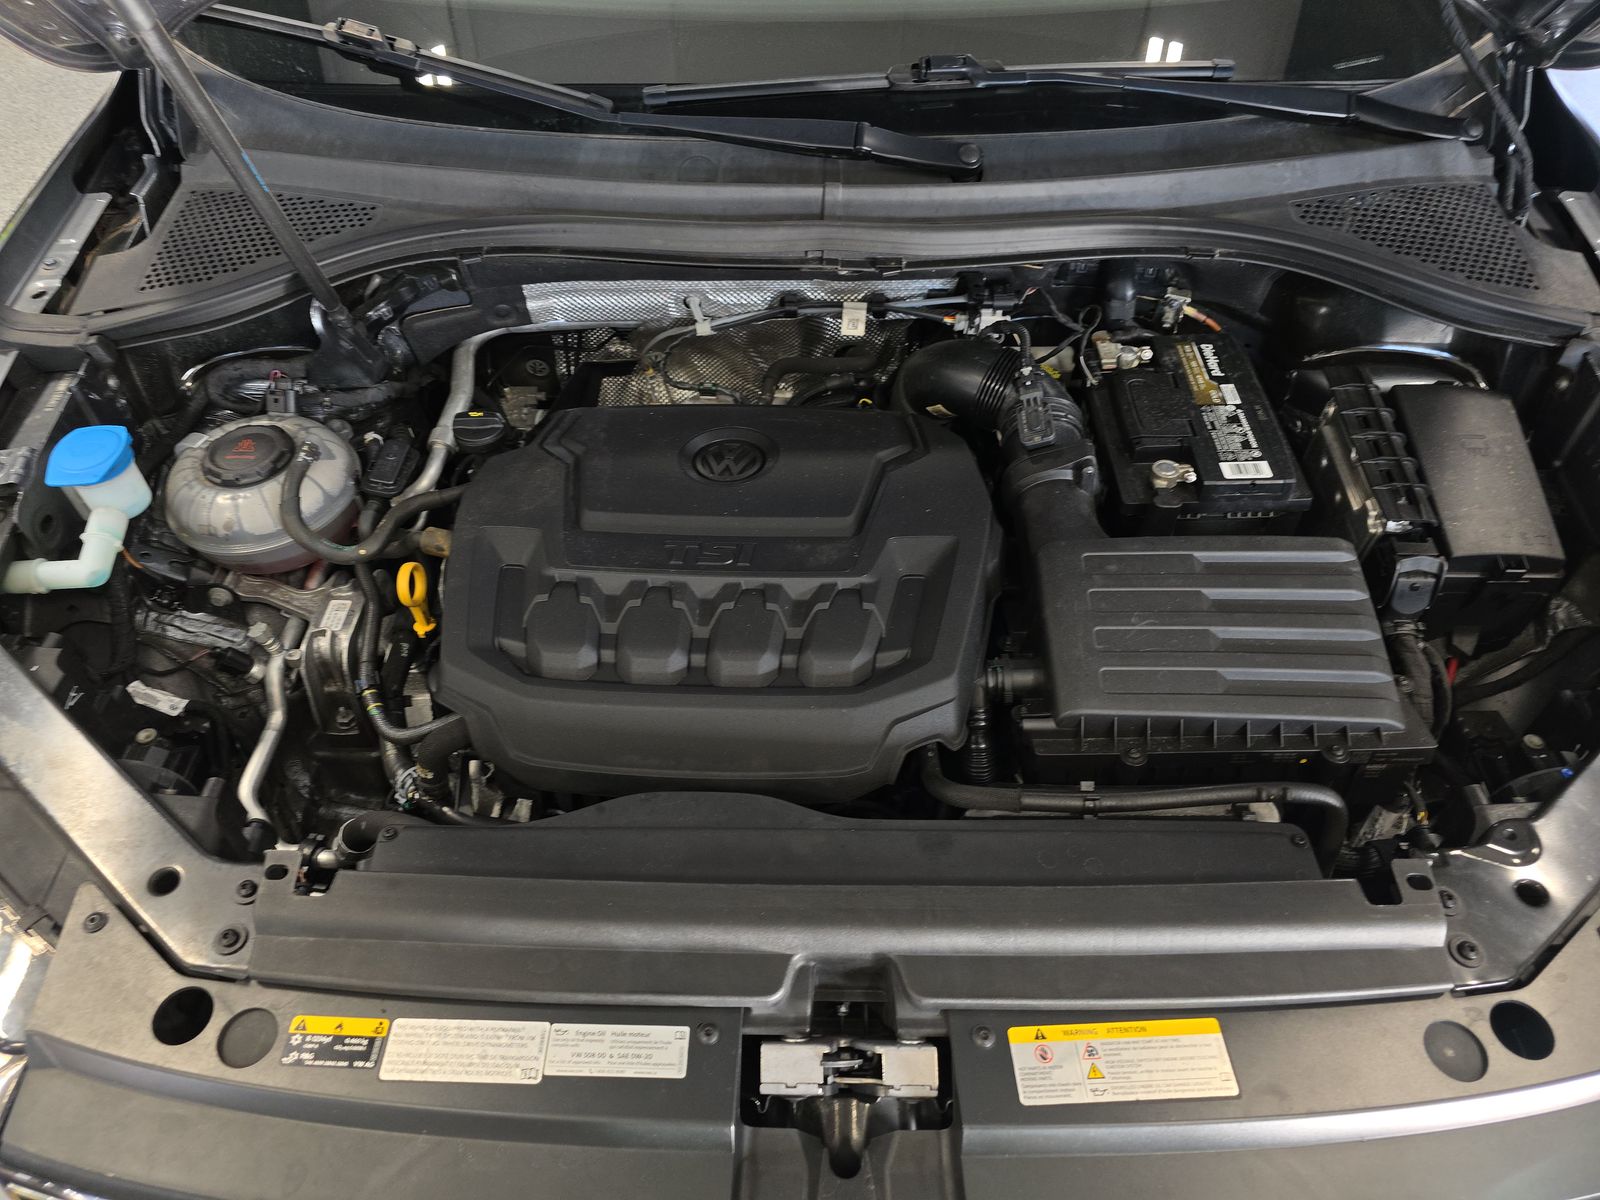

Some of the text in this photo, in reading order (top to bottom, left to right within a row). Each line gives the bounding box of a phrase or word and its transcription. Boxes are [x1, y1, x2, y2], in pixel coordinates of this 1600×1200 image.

[1200, 343, 1225, 377] DieHard
[694, 440, 765, 481] VW
[663, 542, 759, 567] TSI
[1062, 1025, 1148, 1037] WARNING ATTENTION
